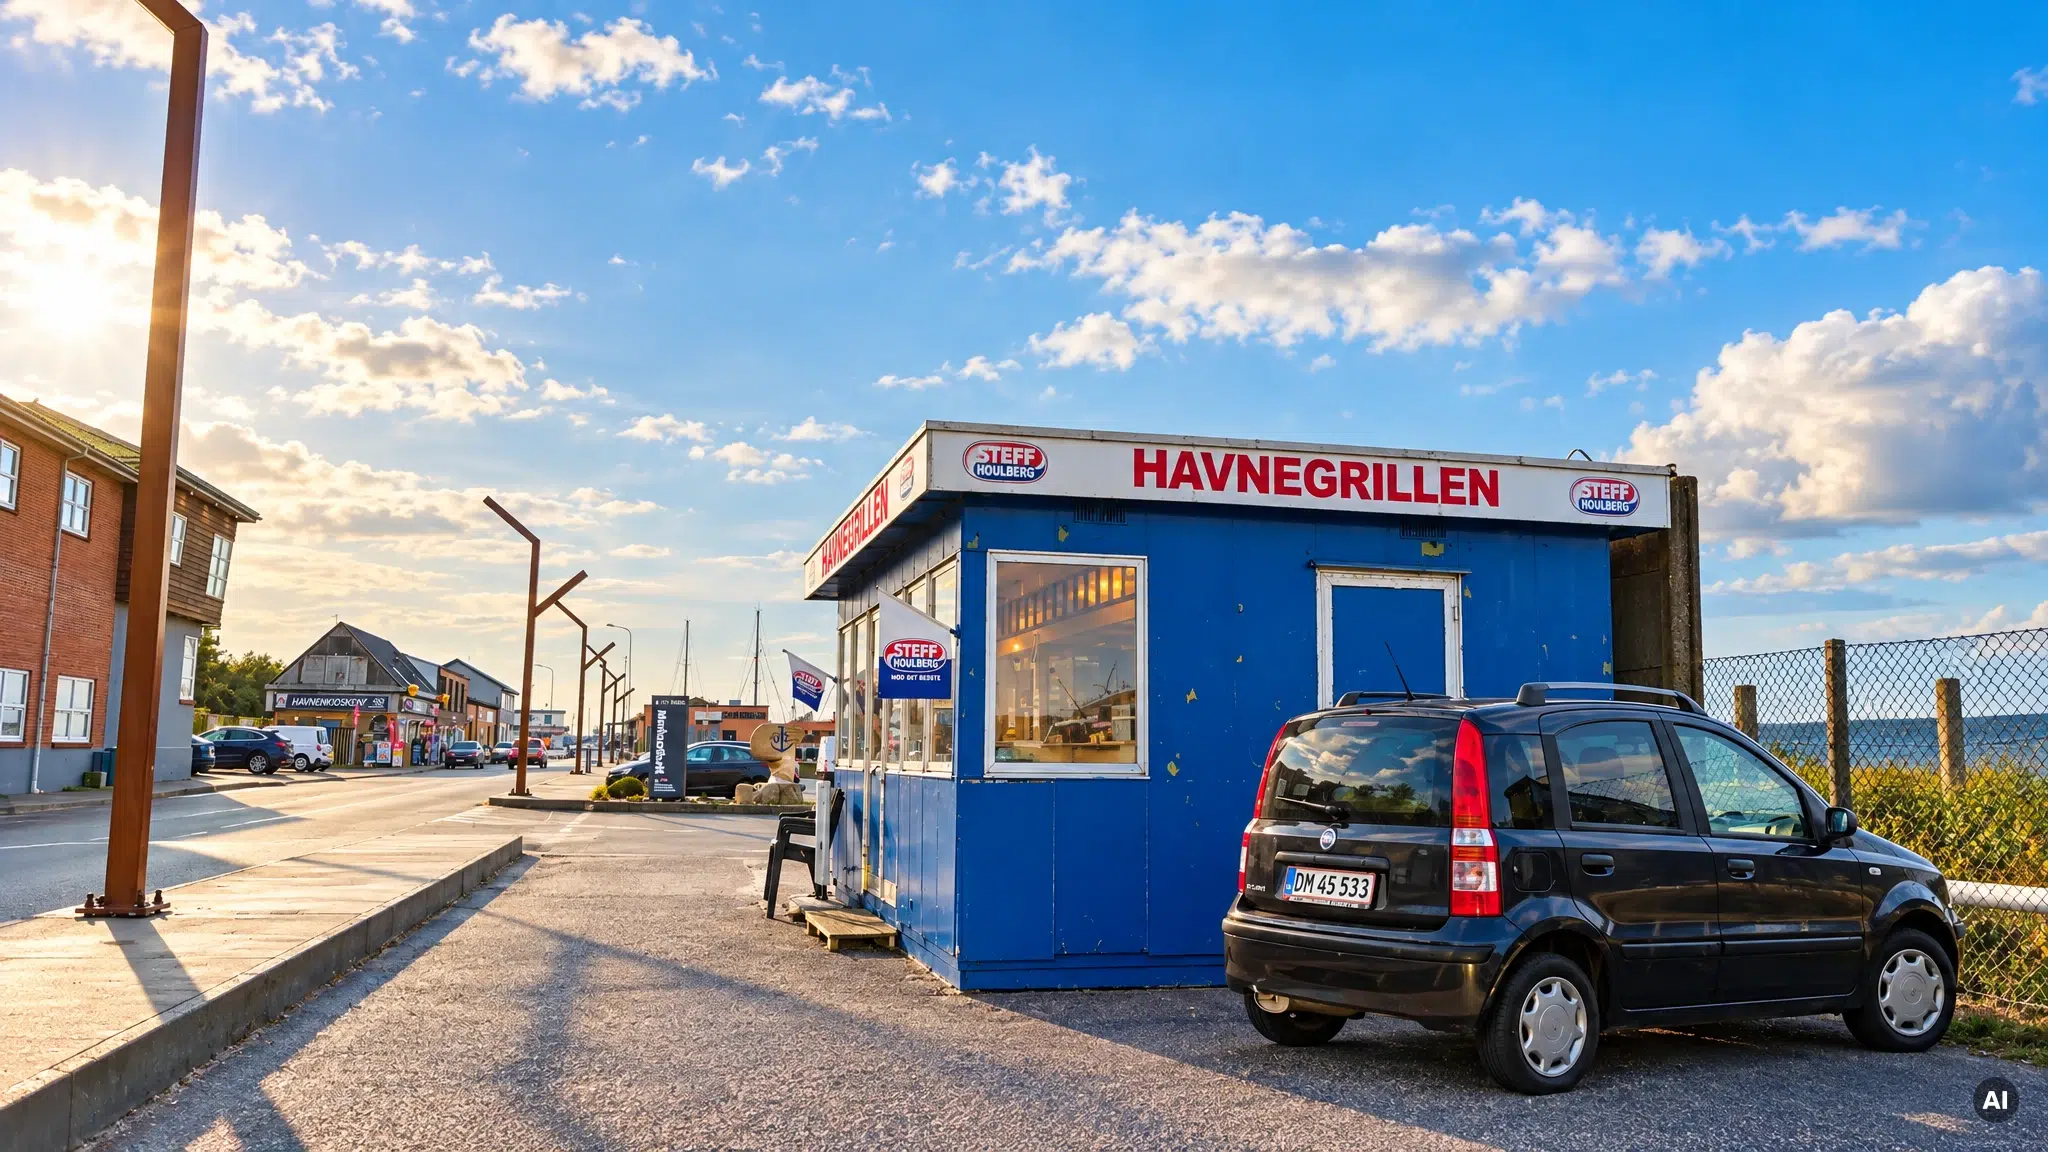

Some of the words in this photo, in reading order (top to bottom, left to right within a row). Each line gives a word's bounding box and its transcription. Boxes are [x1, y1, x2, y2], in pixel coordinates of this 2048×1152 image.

[975, 445, 1036, 466] STEFF
[976, 464, 1035, 479] HOULBERG
[1133, 447, 1499, 508] HAVNEGRILLEN
[1581, 481, 1630, 500] STEFF
[1581, 499, 1630, 512] HOULBERG
[893, 643, 938, 659] STEFF
[893, 658, 939, 669] HOULBERG
[1294, 872, 1316, 894] DM
[1317, 874, 1337, 896] 45
[1338, 876, 1370, 899] 533
